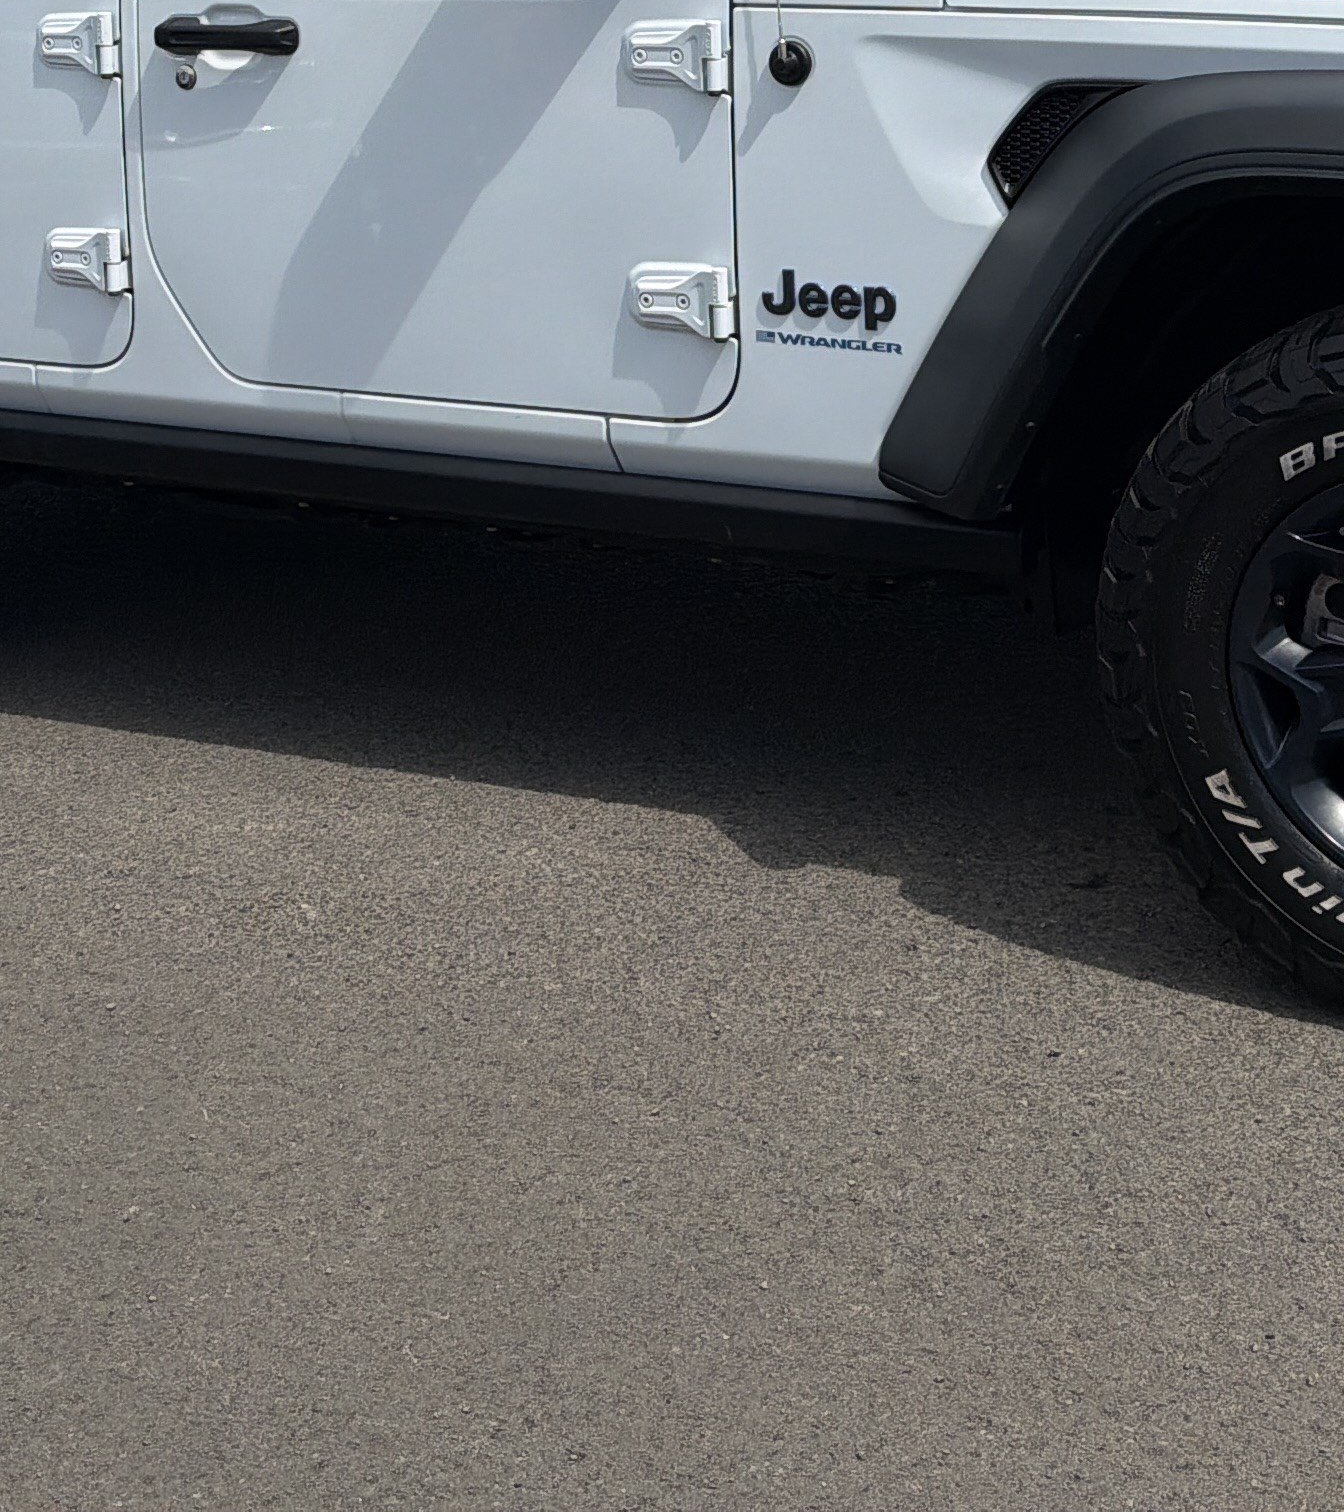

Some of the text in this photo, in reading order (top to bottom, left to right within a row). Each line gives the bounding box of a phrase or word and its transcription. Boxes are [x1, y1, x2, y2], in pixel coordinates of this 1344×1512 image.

[761, 268, 897, 331] Jeep
[777, 331, 904, 356] WRANGLER
[1204, 767, 1281, 866] T/A
